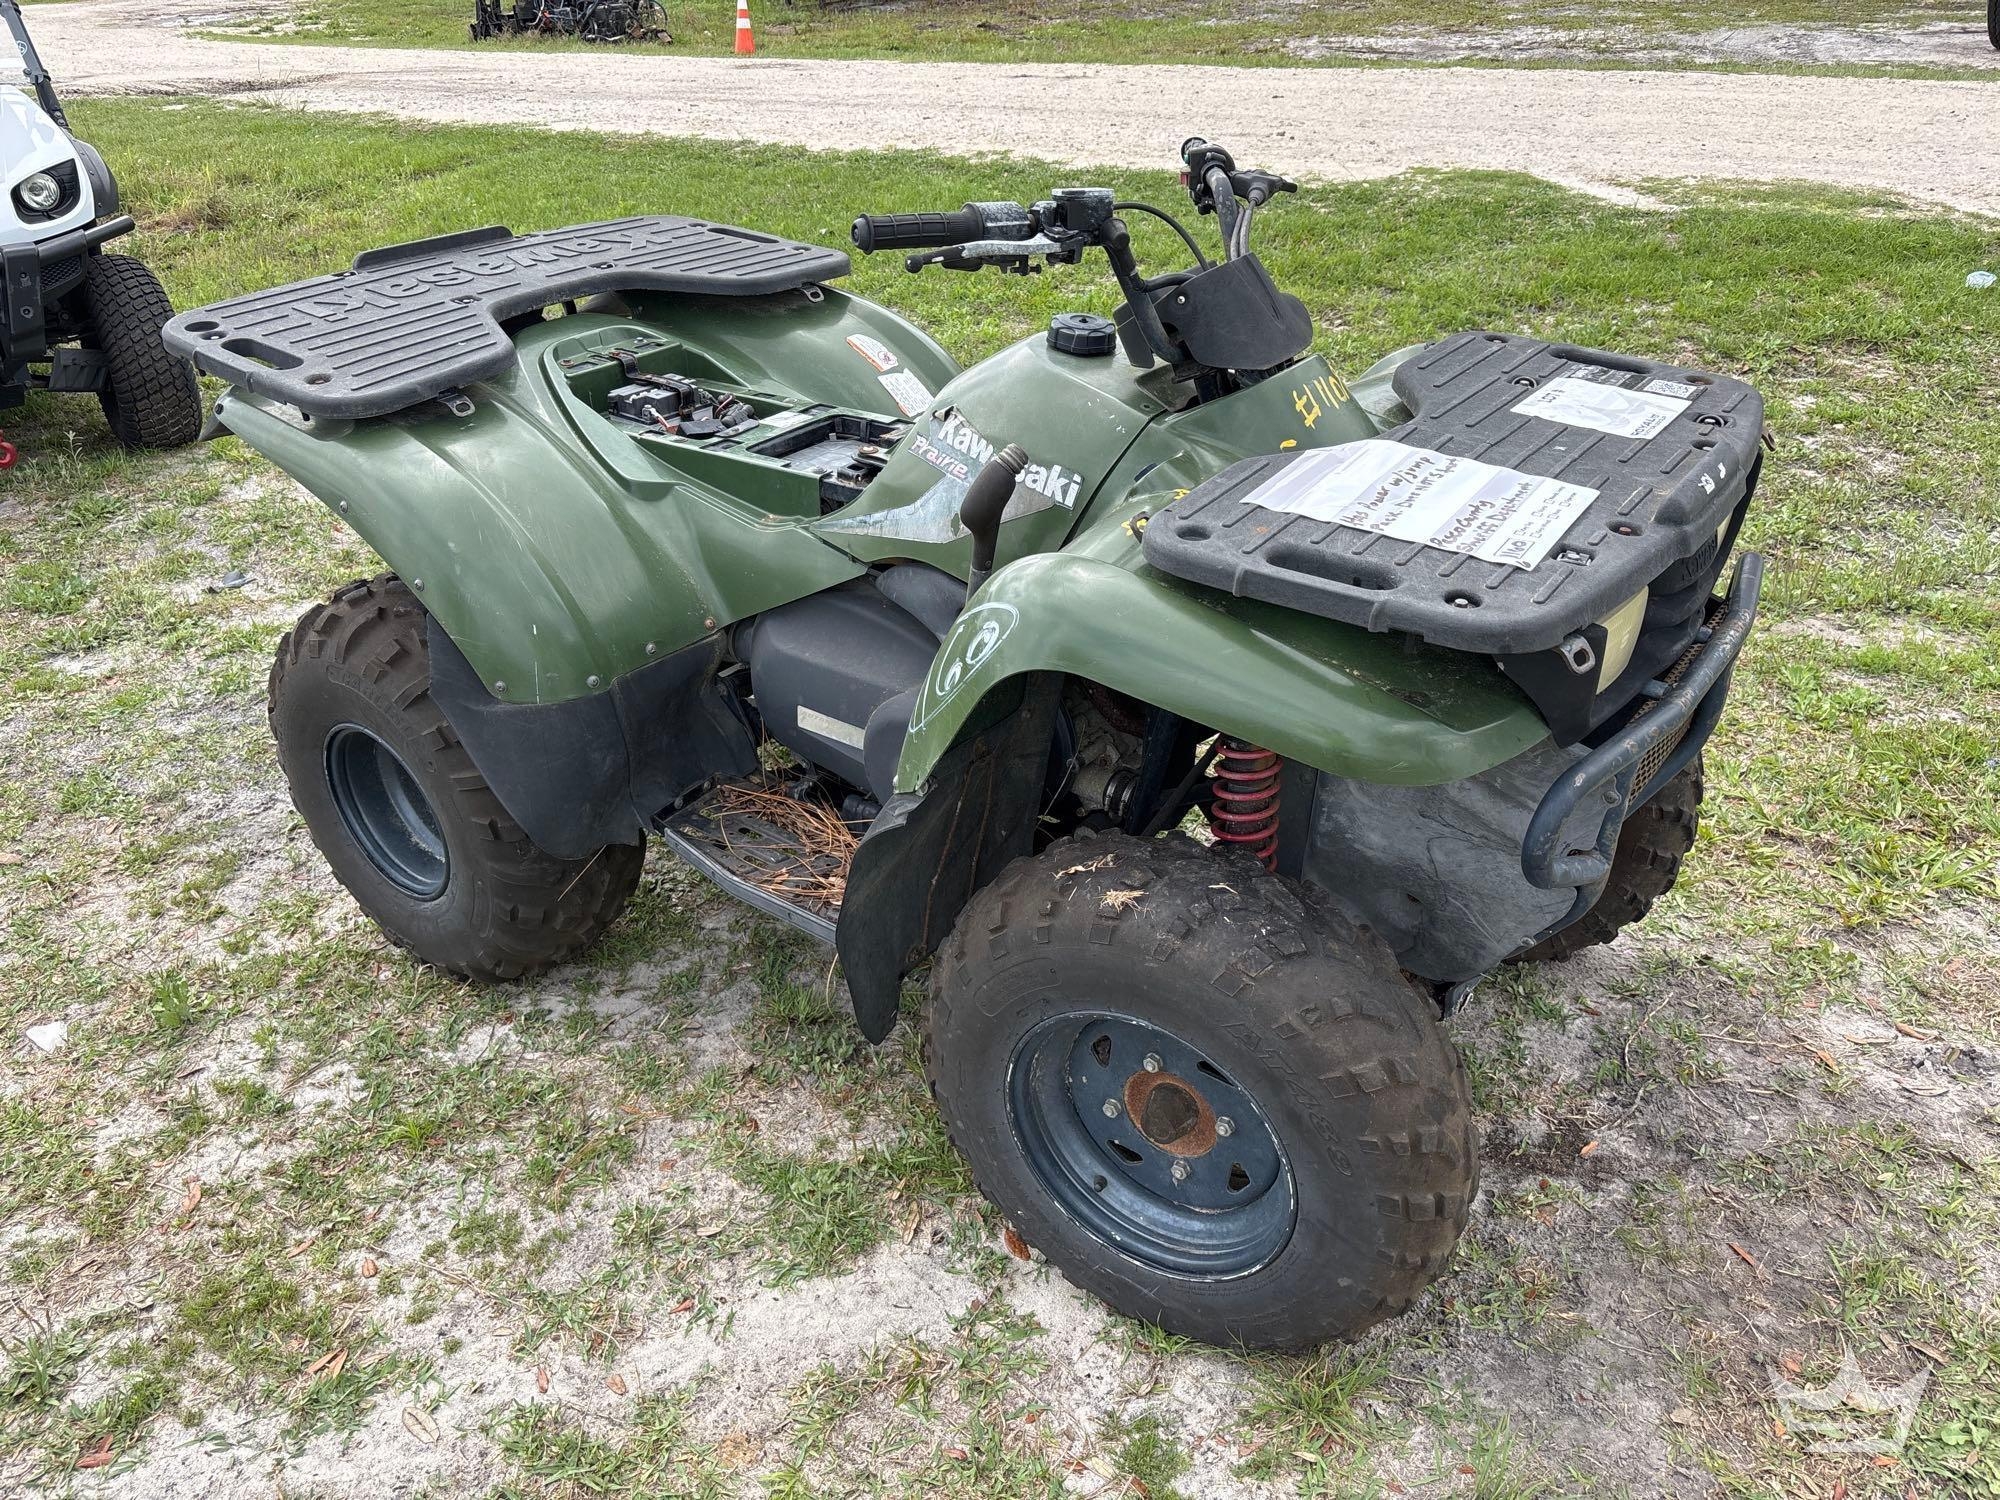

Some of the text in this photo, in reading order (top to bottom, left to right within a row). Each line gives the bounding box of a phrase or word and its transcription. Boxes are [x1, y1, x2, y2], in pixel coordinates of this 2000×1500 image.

[291, 231, 673, 323] Kawasaki
[911, 434, 969, 479] Prairie
[1339, 510, 1369, 527] Has
[1356, 485, 1390, 511] Power
[1456, 500, 1496, 530] County
